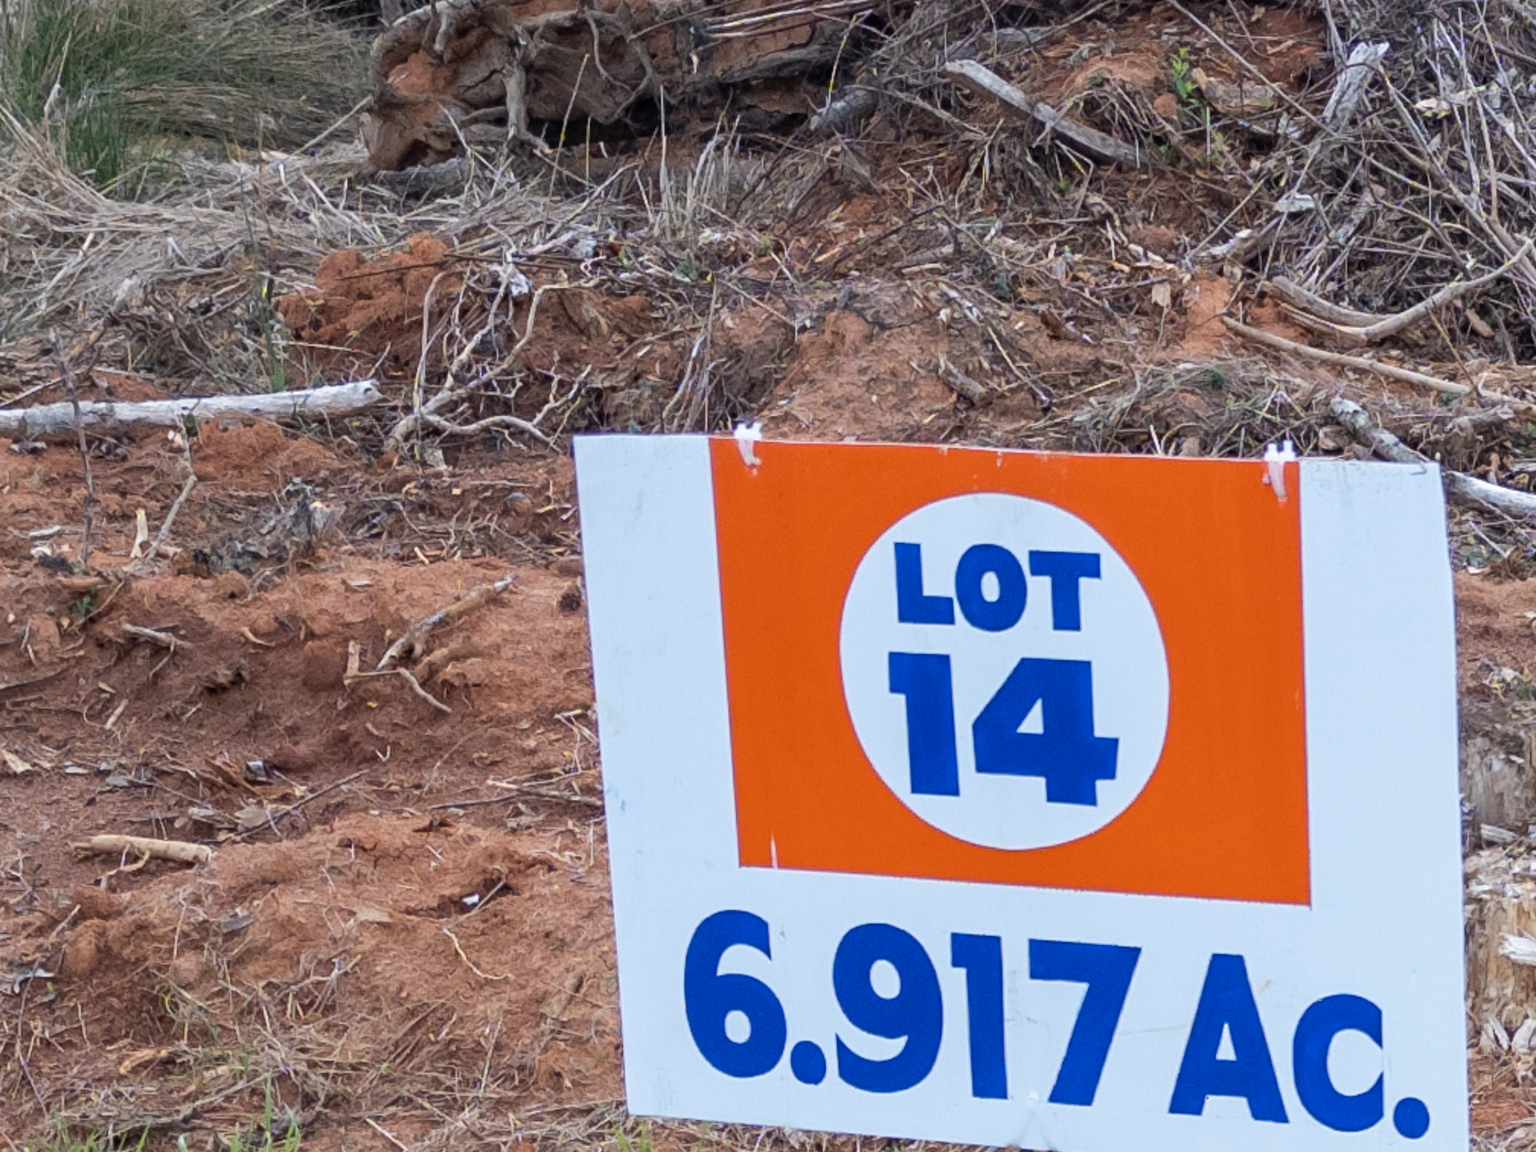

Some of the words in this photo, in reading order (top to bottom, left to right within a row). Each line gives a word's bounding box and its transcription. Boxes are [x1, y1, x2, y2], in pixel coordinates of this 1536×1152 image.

[893, 541, 1102, 632] LOT
[887, 651, 1120, 807] 14
[683, 909, 1142, 1107] 6.917
